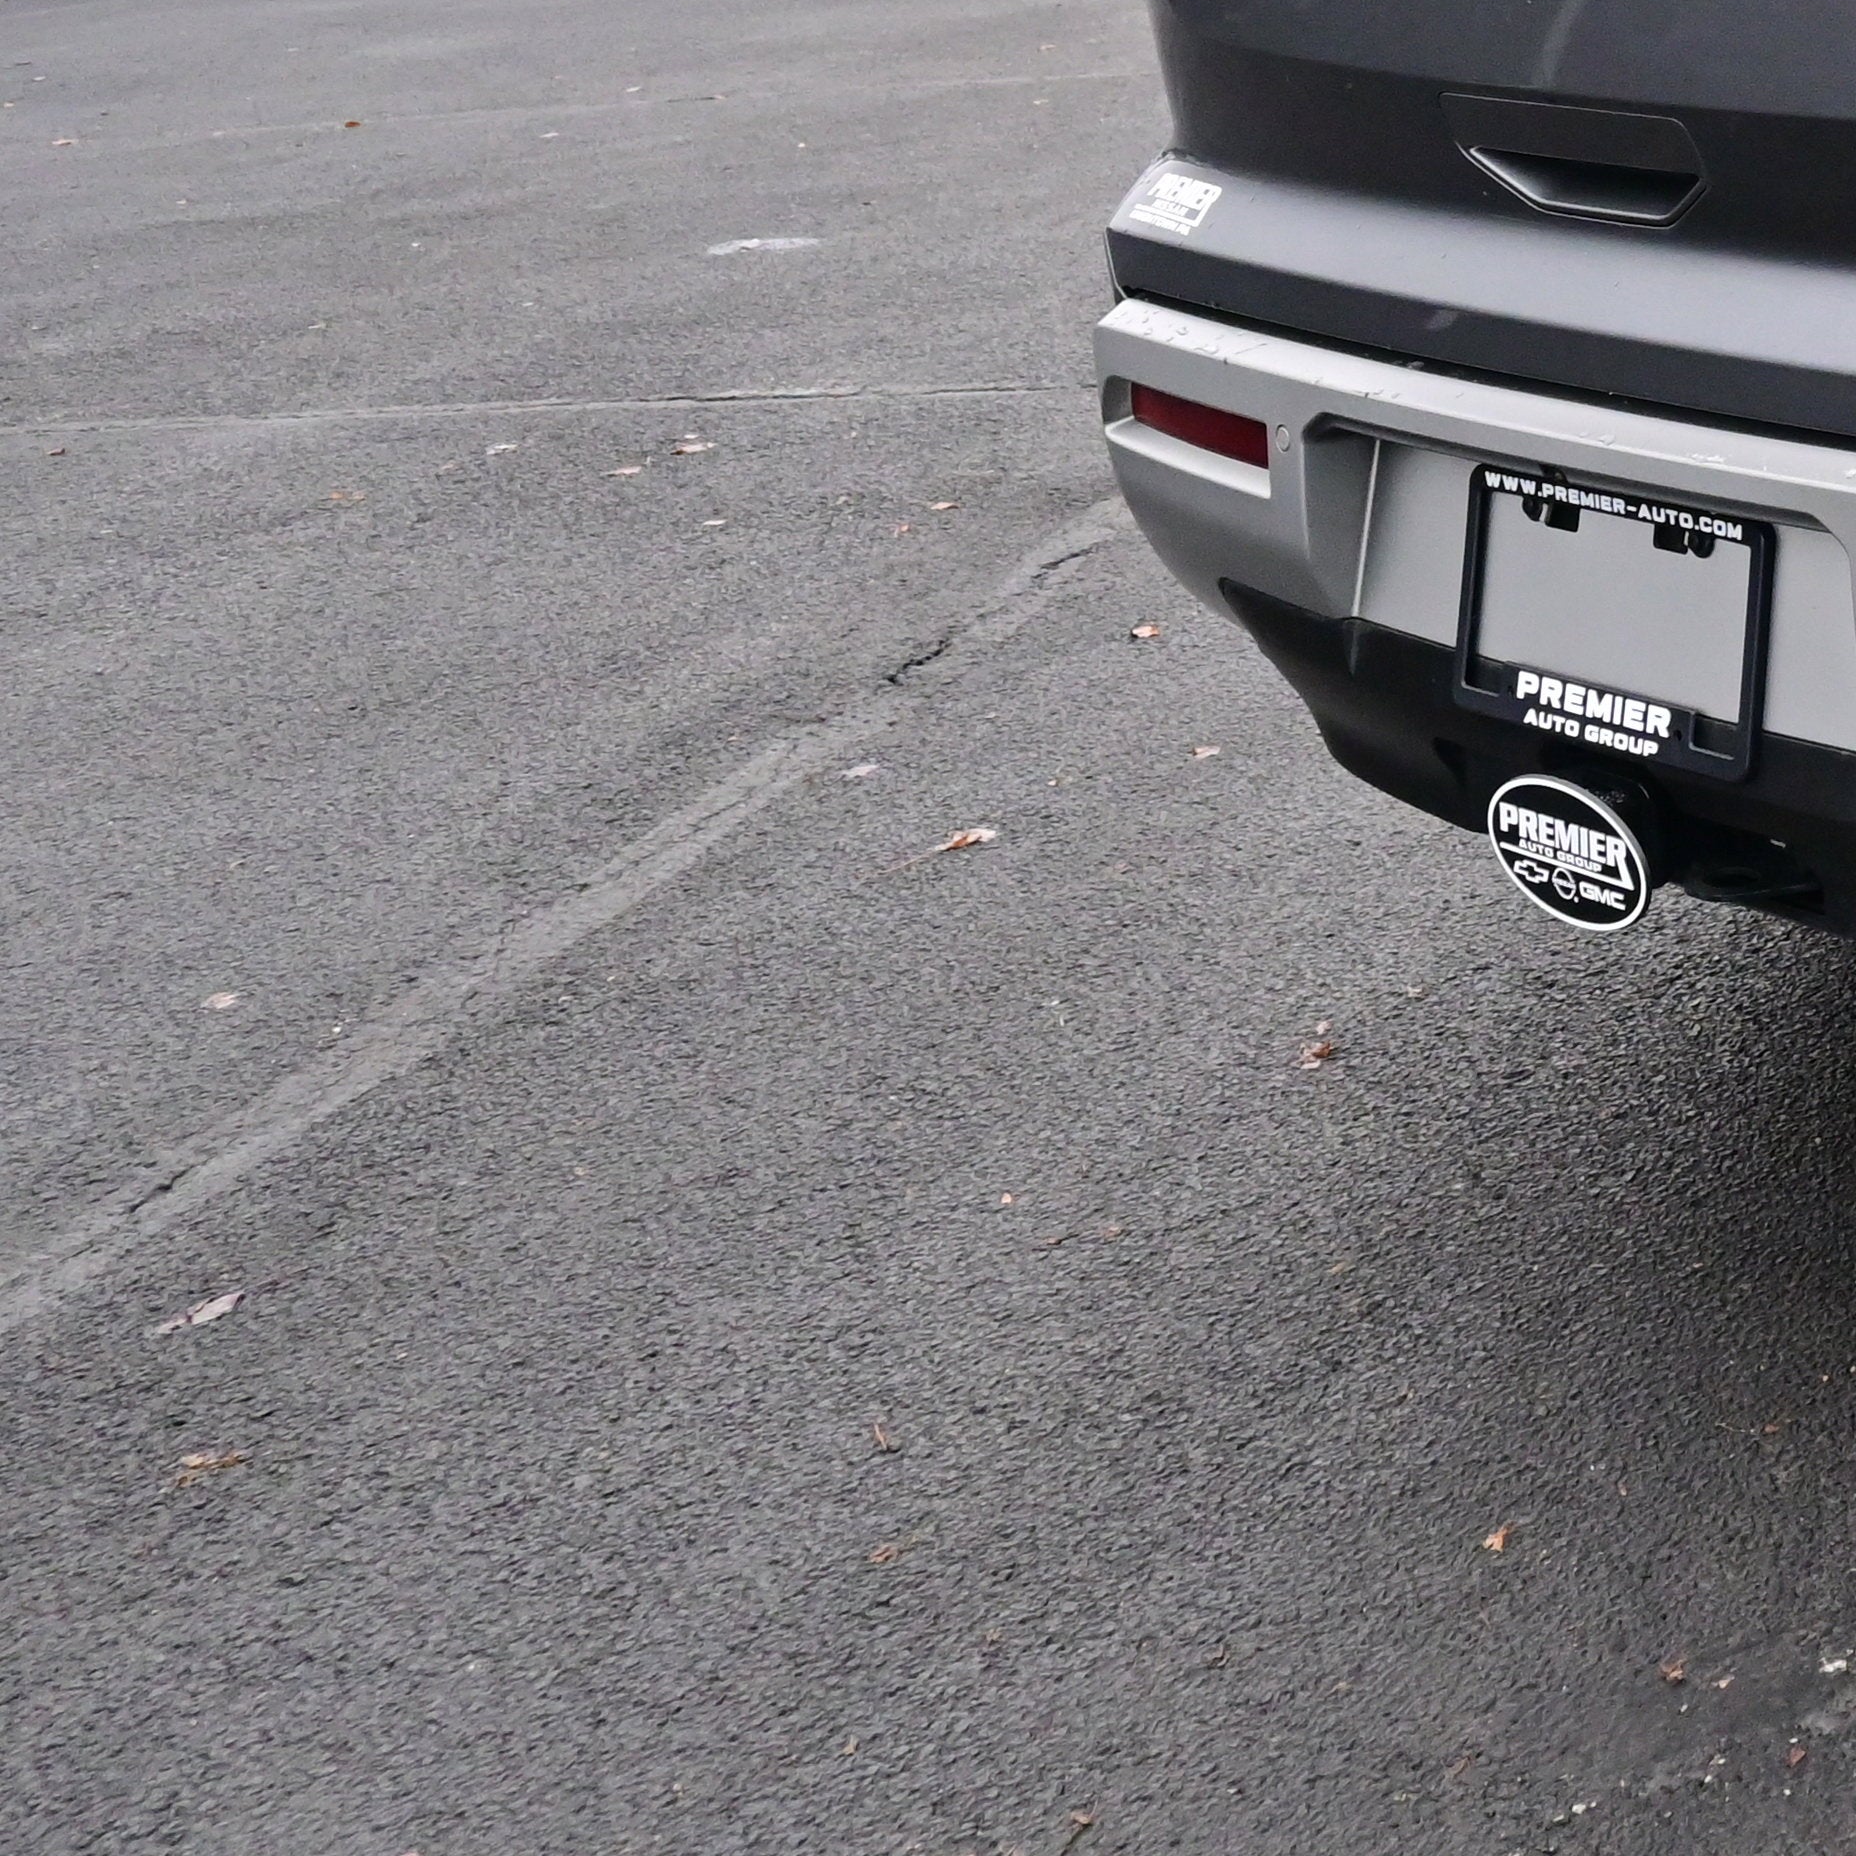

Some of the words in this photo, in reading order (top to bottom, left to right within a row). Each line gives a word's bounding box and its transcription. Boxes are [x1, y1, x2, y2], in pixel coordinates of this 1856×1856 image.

[1484, 471, 1743, 540] WWW.PREMIER-AUTO.COM
[1516, 671, 1672, 738] PREMIER
[1523, 709, 1580, 737] AUTO
[1584, 724, 1659, 757] GROUP
[1499, 802, 1627, 867] PREMIER
[1519, 839, 1554, 859] AUTO
[1556, 850, 1602, 873] GROUP
[1579, 881, 1626, 911] GMC
